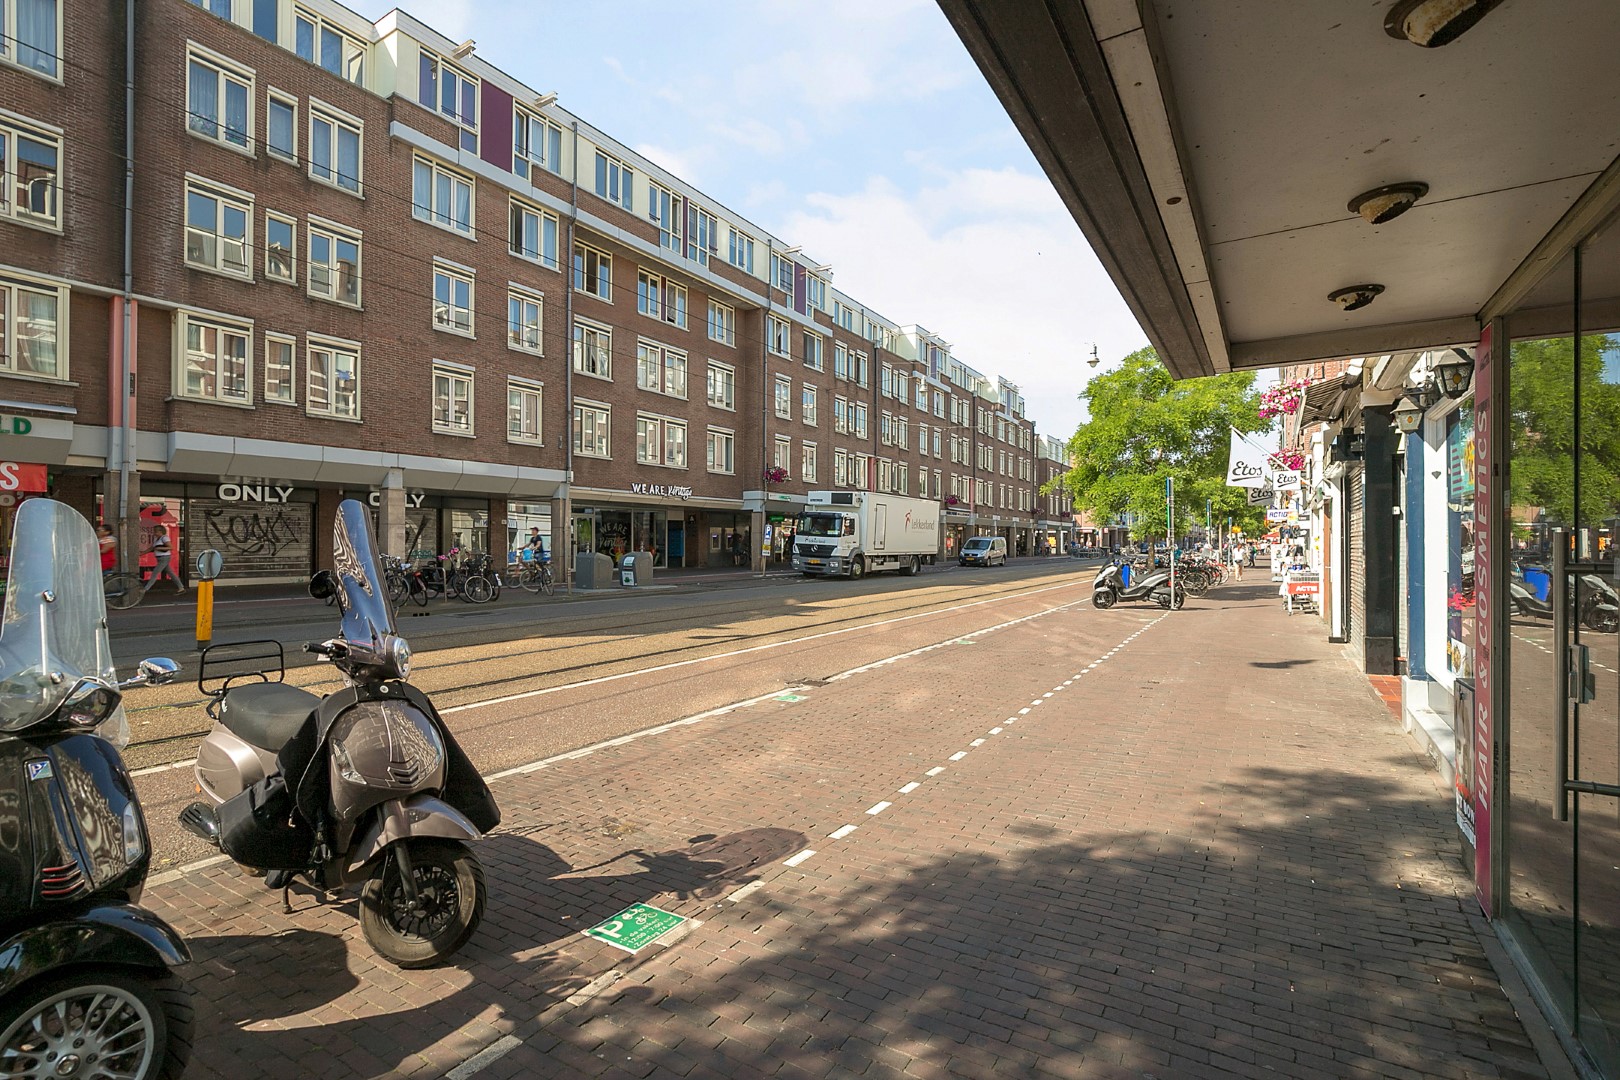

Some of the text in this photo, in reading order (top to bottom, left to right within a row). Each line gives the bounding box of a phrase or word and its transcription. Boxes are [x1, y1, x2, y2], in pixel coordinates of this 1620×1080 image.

[1232, 461, 1262, 476] Etos
[1277, 474, 1298, 484] Etos
[218, 484, 294, 502] ONLY
[369, 492, 426, 508] OLY
[1251, 488, 1273, 499] Etos
[1477, 410, 1488, 811] HAIR & COSMETICS
[594, 920, 624, 939] P
